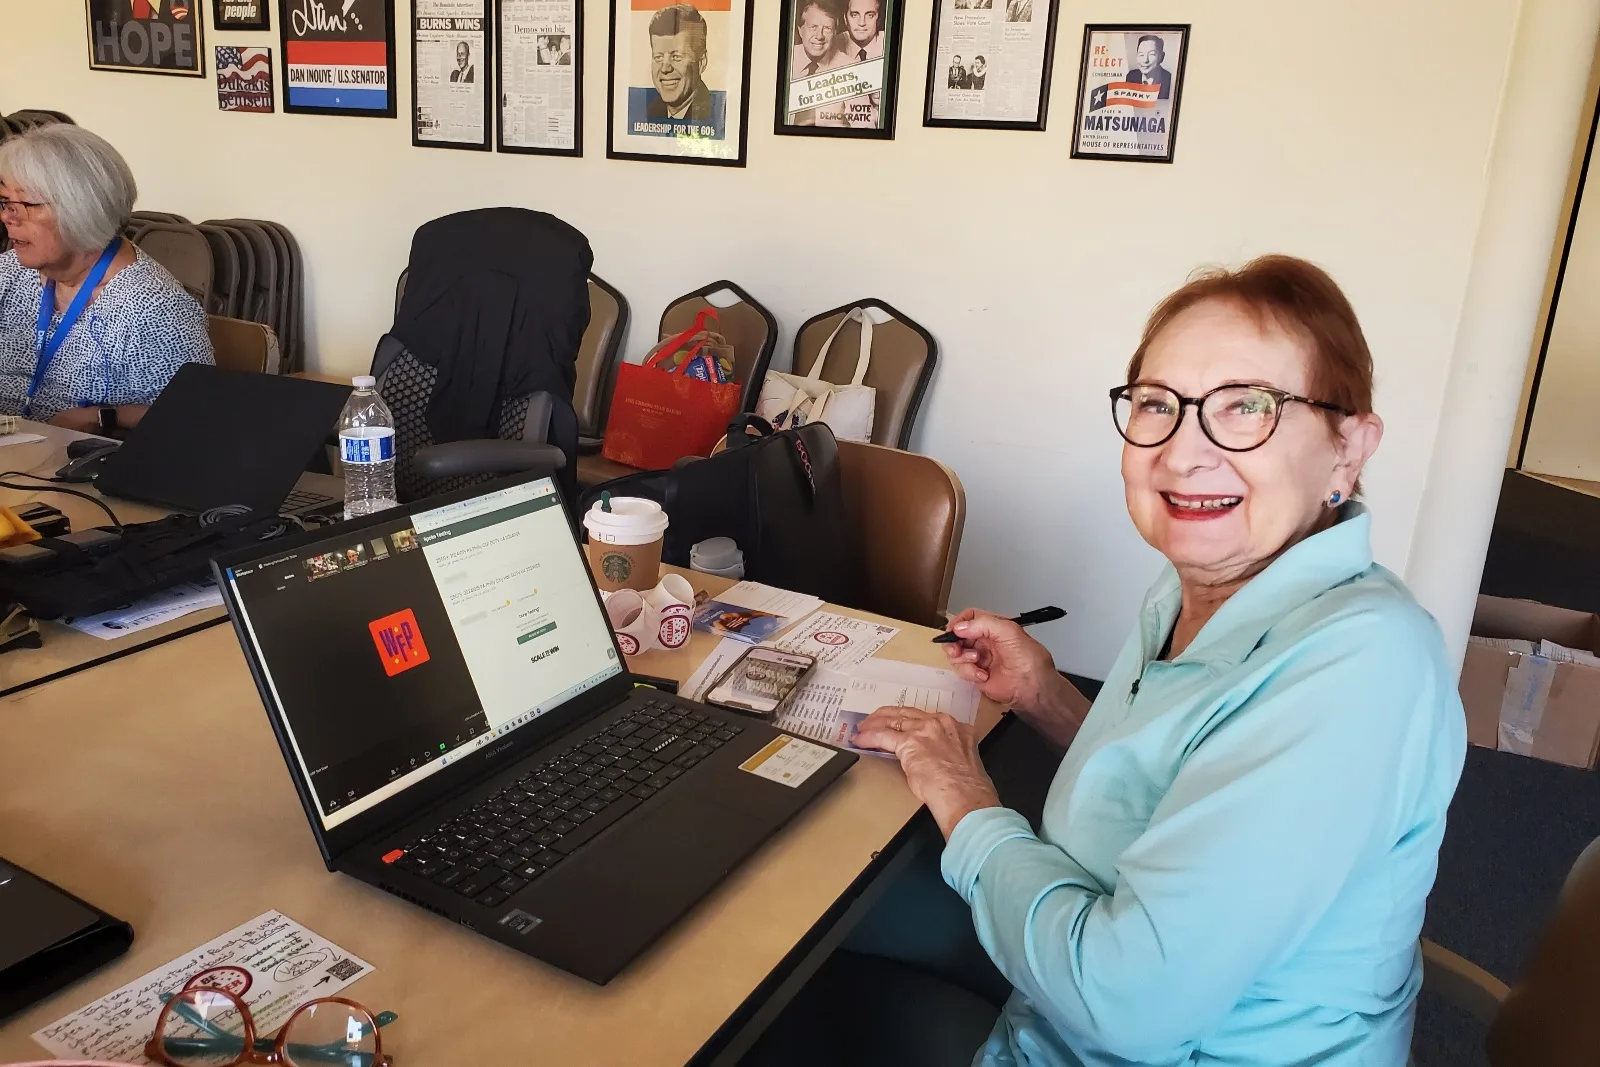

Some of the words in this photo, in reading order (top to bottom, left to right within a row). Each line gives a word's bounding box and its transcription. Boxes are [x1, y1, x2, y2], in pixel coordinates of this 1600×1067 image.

[224, 2, 257, 20] people
[420, 18, 452, 30] BURNS
[454, 18, 480, 30] WINS
[514, 24, 538, 34] Demos
[540, 24, 553, 33] win
[554, 24, 566, 34] big
[95, 20, 192, 66] HOPE
[1094, 46, 1109, 55] RE-
[1093, 58, 1123, 67] ELECT
[217, 74, 270, 91] Dukakis
[290, 68, 304, 82] DAN
[306, 69, 332, 83] INOUYE
[337, 69, 351, 83] U.S.
[351, 70, 385, 84] SENATOR
[807, 71, 859, 92] Leaders,
[798, 93, 816, 106] for
[816, 93, 823, 102] a
[824, 81, 873, 100] change.
[1113, 90, 1151, 99] SPARKY
[850, 104, 871, 113] VOTE
[820, 111, 871, 122] DEMOCRATIC
[634, 122, 672, 134] LEADERSHIP
[673, 124, 686, 135] FOR
[687, 125, 700, 136] THE
[1084, 115, 1166, 134] MATSUNAGA
[1112, 142, 1164, 150] REPRESENTATIVES
[680, 625, 686, 634] BE
[379, 621, 414, 662] WFP
[531, 652, 546, 663] SCALE
[199, 951, 235, 970] Harris
[200, 974, 218, 985] BE
[41, 1019, 78, 1039] Dear
